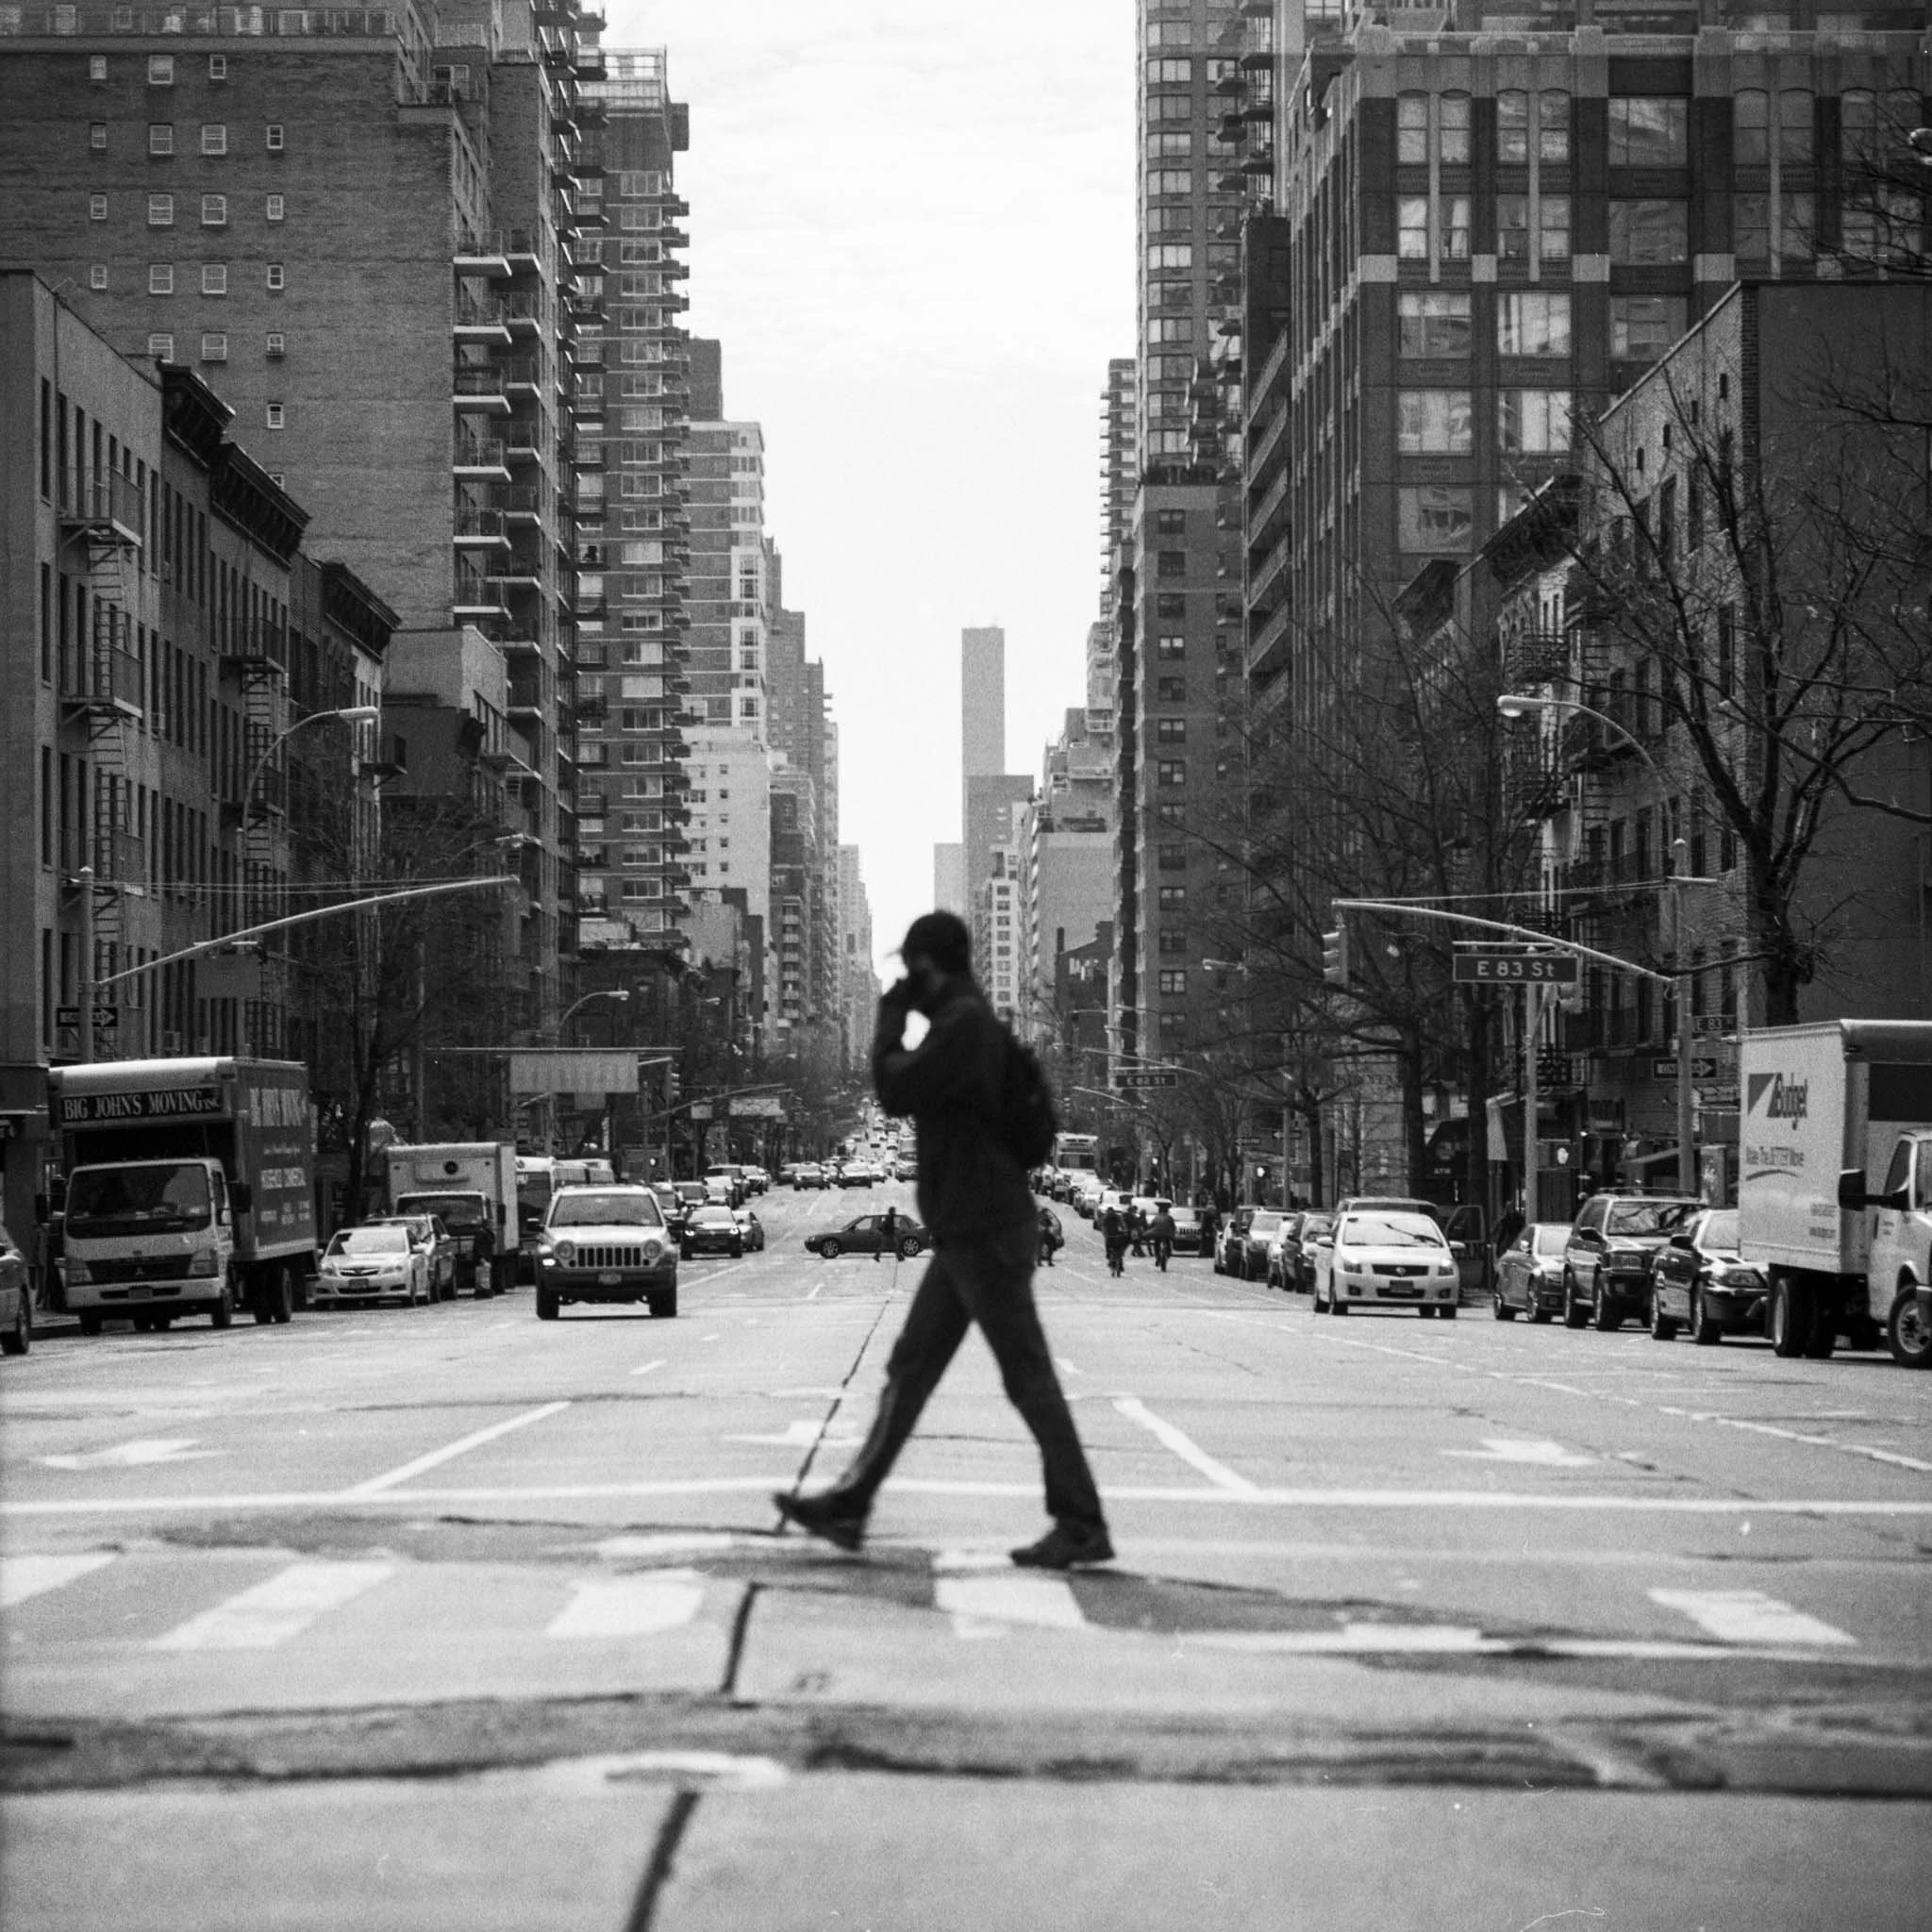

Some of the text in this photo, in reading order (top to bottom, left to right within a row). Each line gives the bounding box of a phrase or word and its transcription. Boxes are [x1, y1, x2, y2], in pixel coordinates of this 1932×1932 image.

[1476, 960, 1556, 977] E 83 St
[1707, 1018, 1722, 1031] 83
[63, 1097, 89, 1121] BIG
[147, 1090, 203, 1115] MOVING
[1768, 1072, 1808, 1131] Budget
